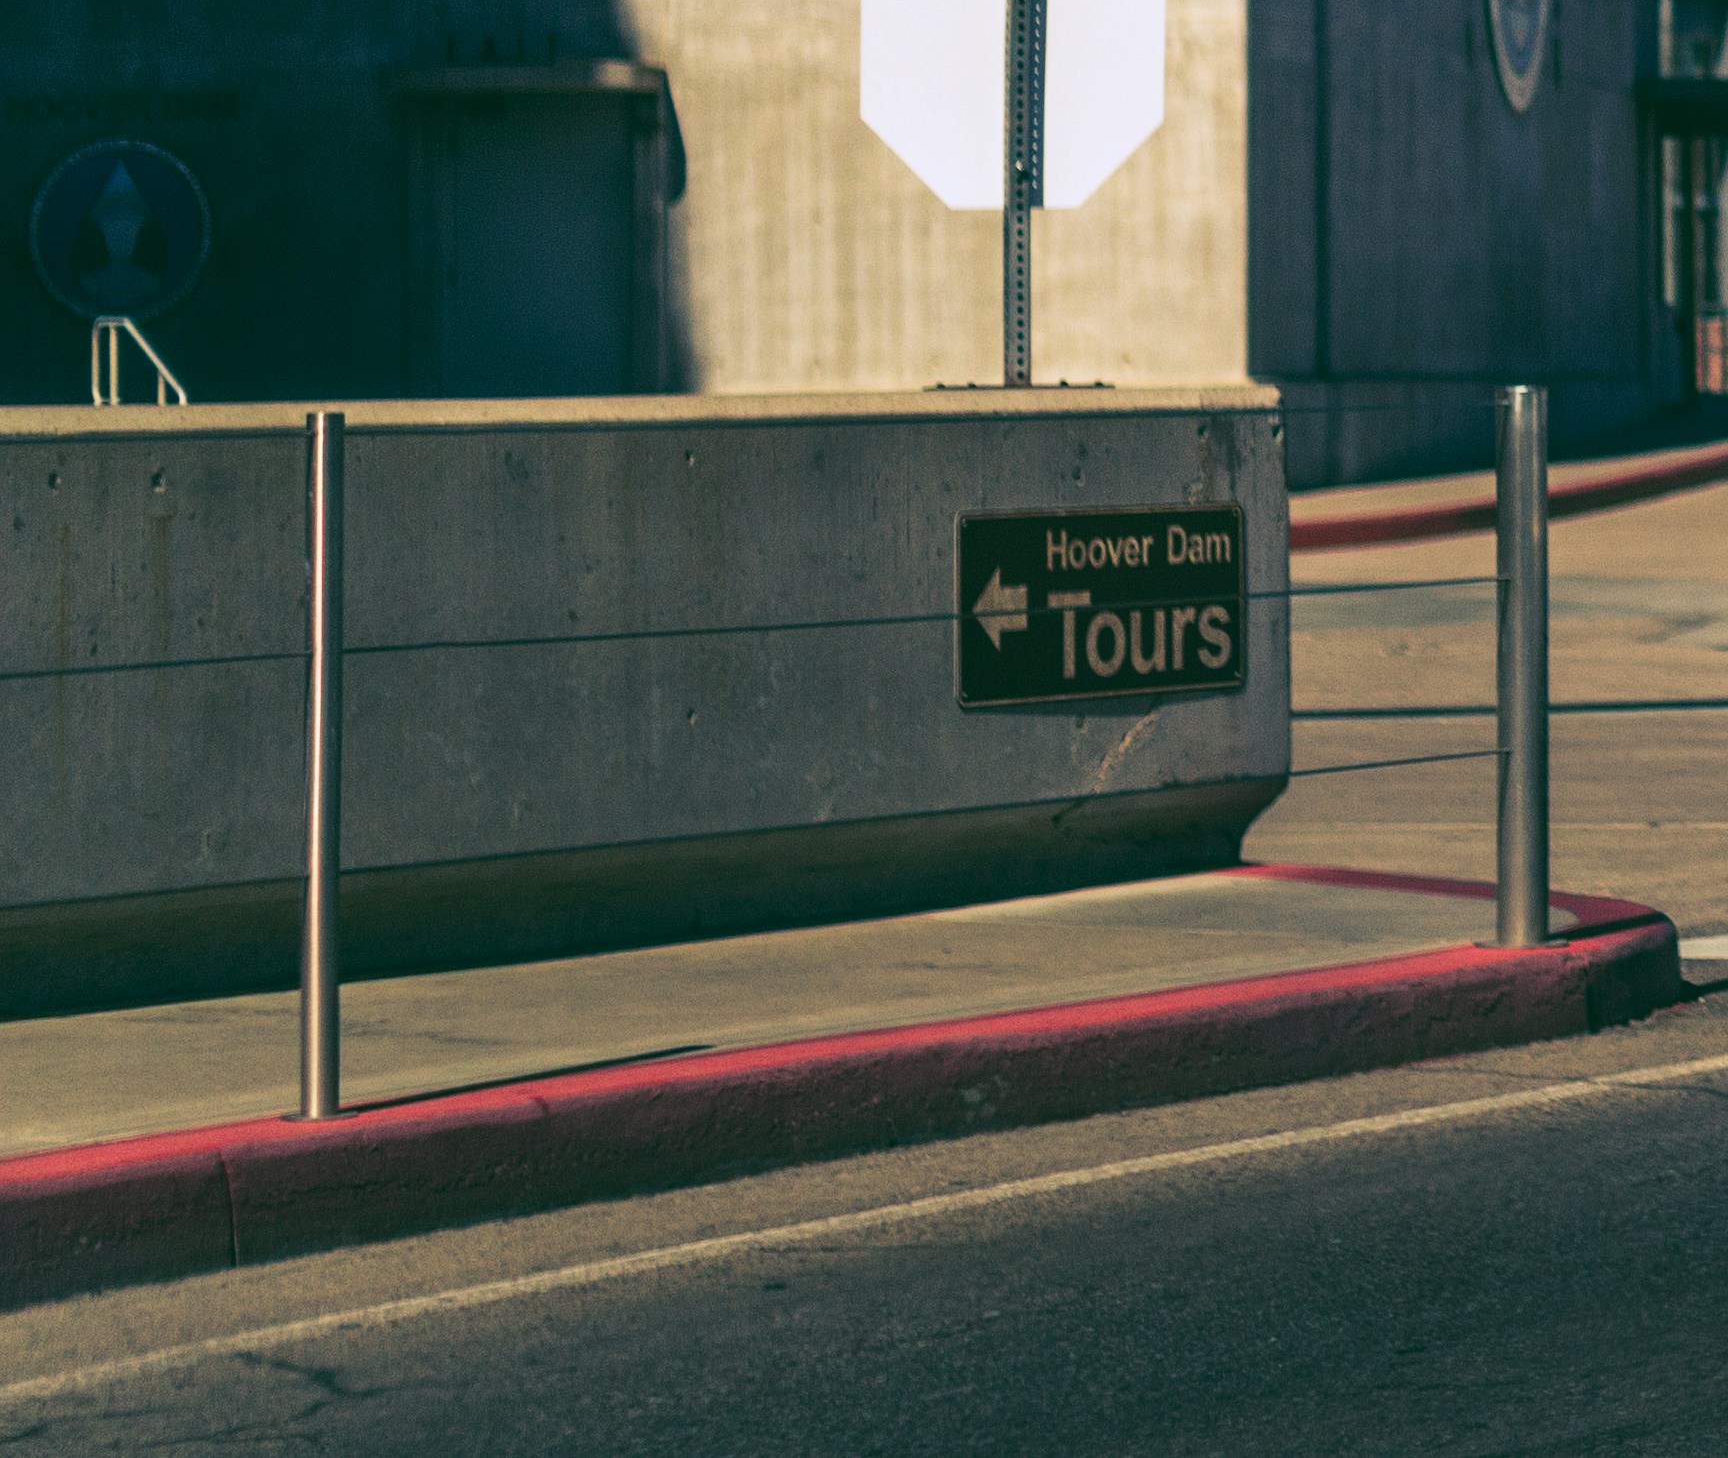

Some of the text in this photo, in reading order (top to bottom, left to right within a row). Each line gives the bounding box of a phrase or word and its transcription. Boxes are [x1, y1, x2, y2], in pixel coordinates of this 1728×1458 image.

[1046, 524, 1231, 571] Hoover Dam
[1047, 590, 1232, 679] Tours
